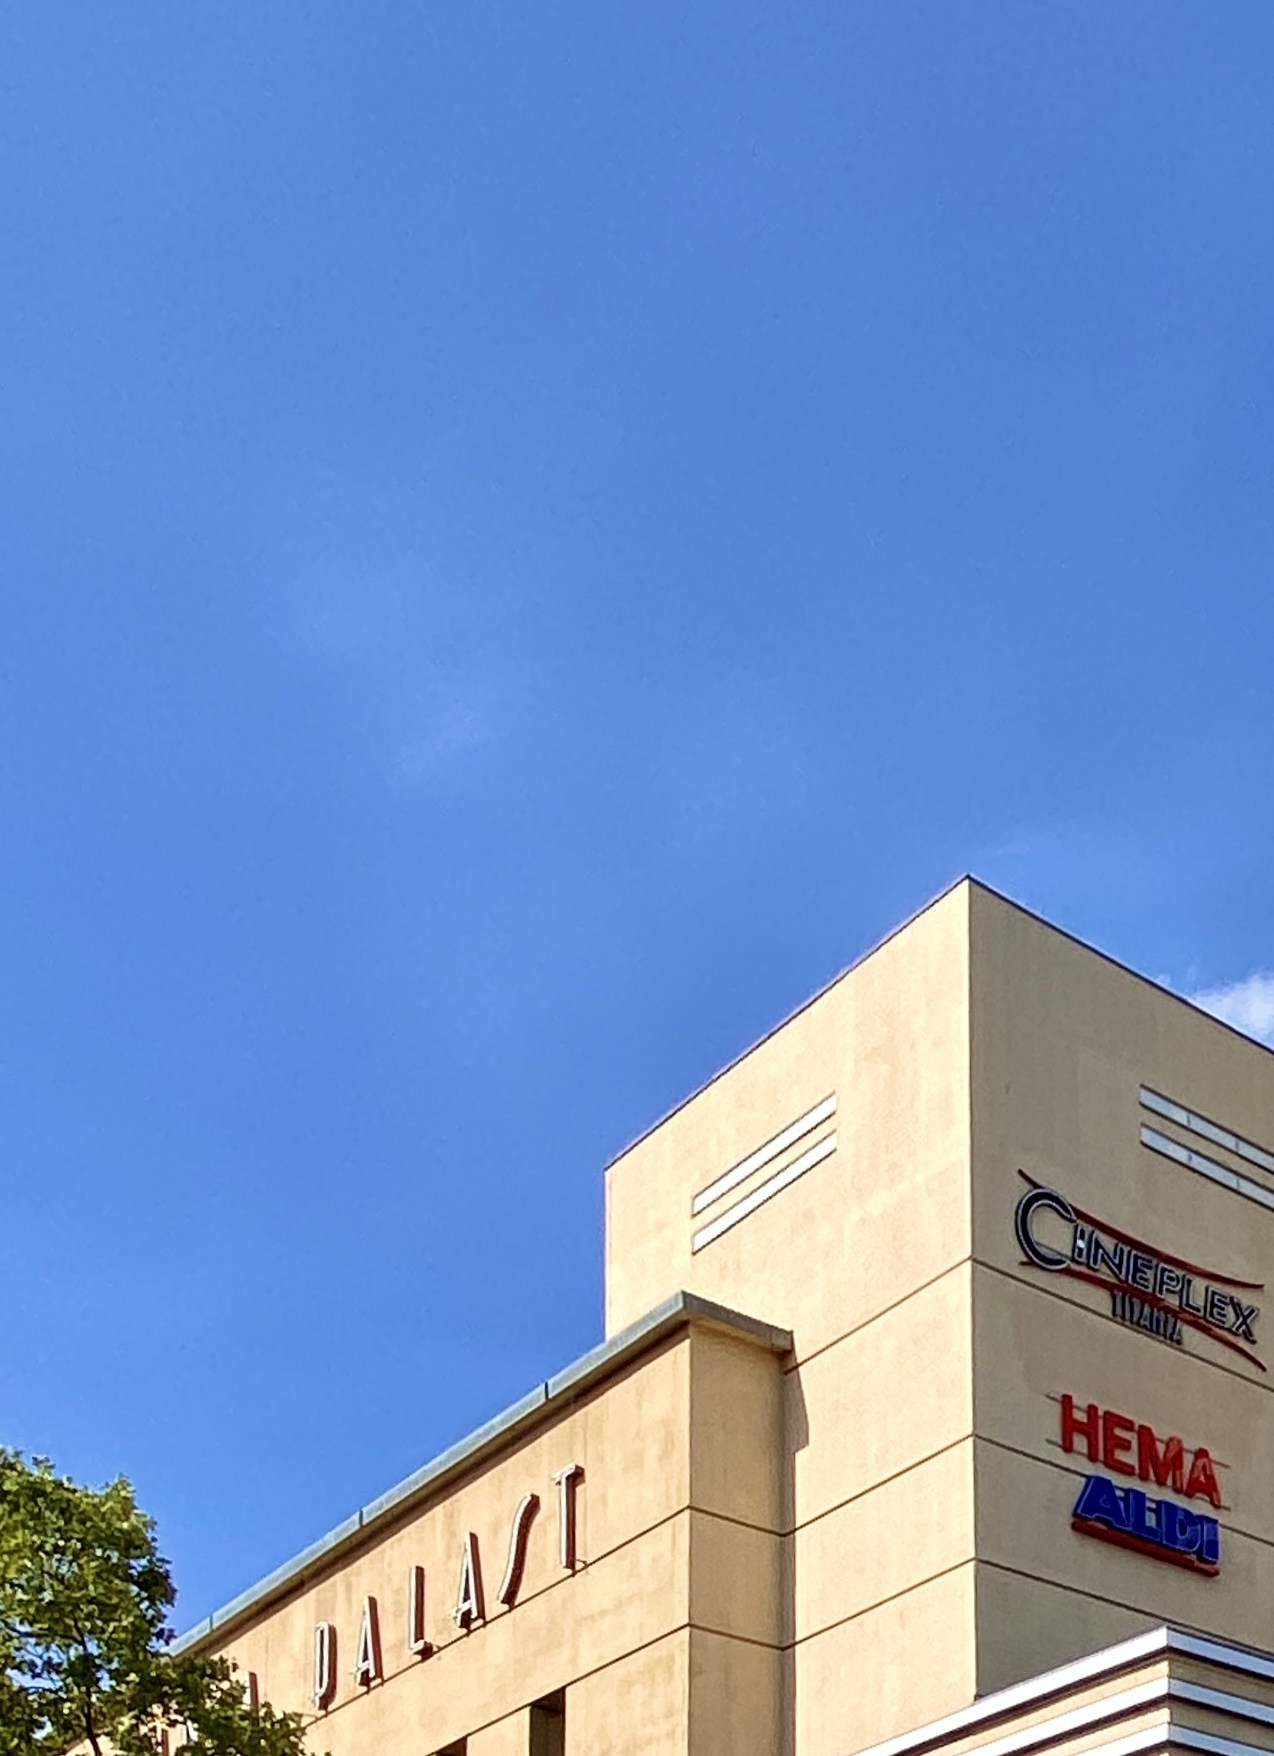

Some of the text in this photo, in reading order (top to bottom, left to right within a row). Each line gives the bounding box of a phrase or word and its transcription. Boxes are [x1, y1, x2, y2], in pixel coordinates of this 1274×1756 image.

[1014, 1188, 1260, 1344] CINEPLEX
[1059, 1393, 1221, 1510] HEMA
[1072, 1474, 1220, 1565] ALDI
[312, 1463, 586, 1711] PALAST
